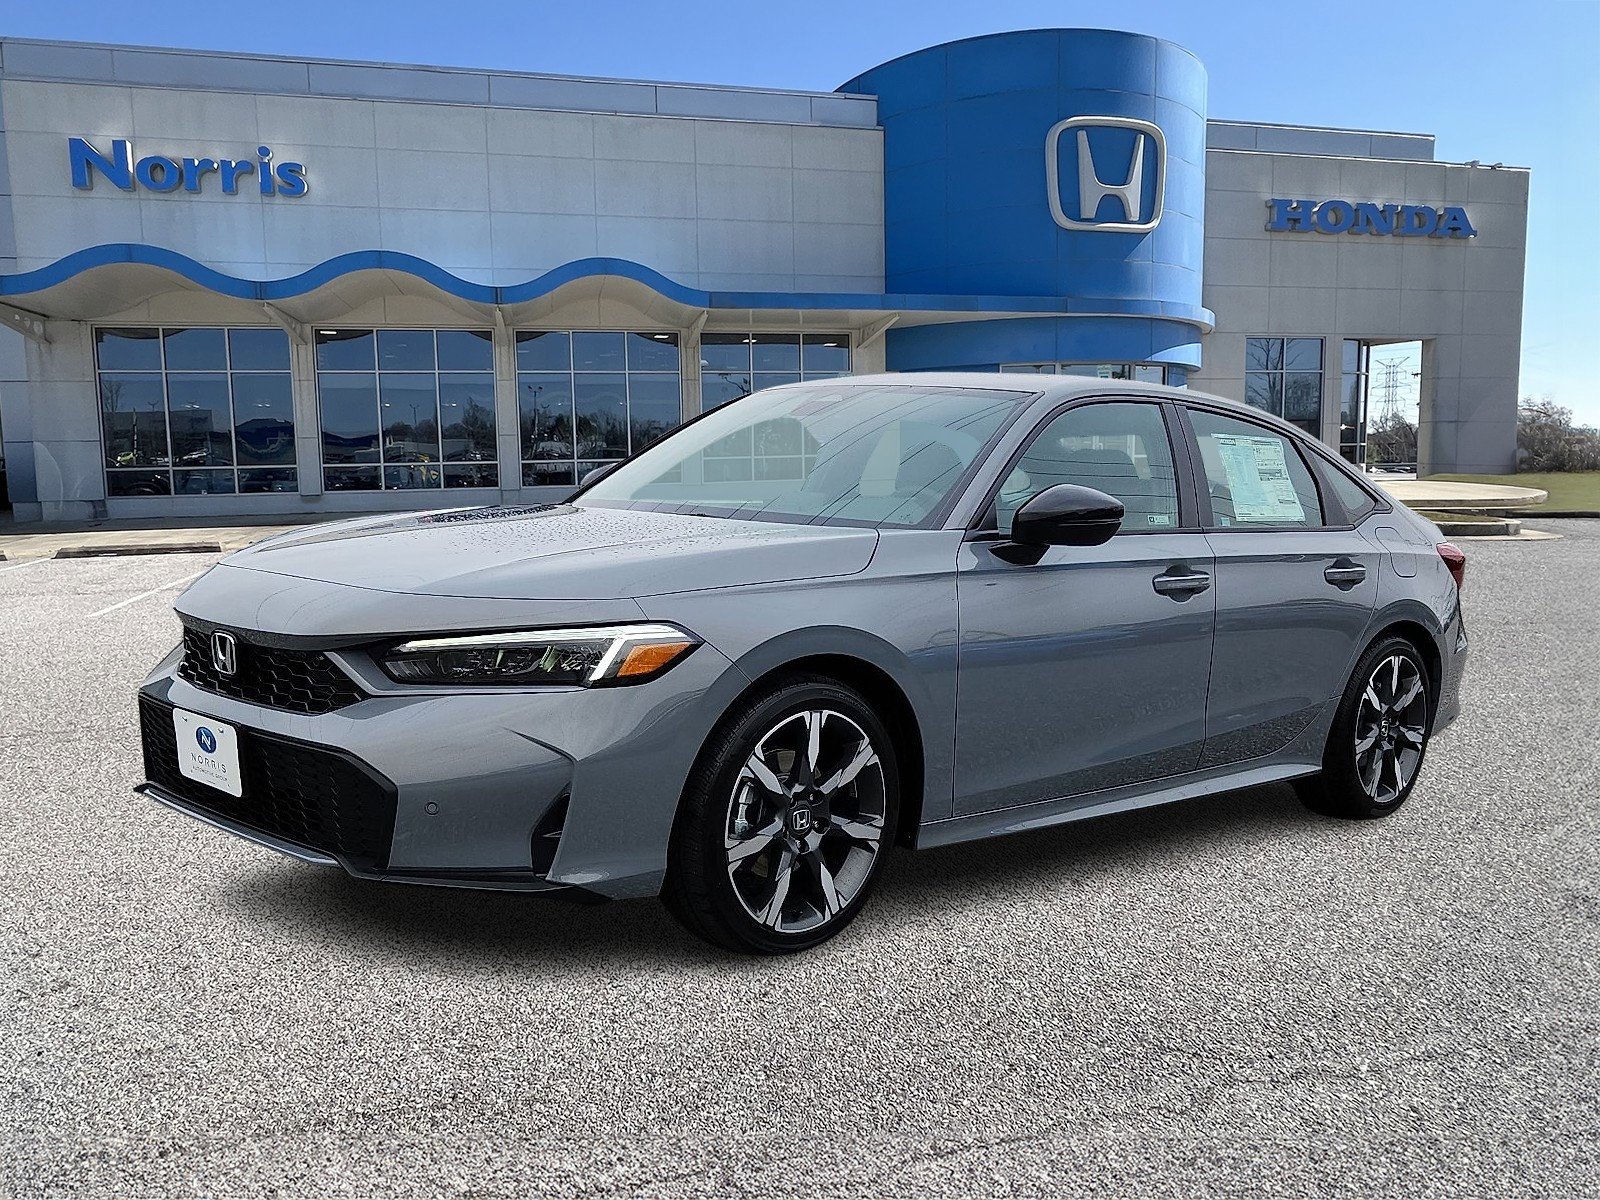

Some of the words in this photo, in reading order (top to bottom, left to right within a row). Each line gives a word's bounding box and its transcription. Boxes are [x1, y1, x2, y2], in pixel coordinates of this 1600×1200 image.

[68, 137, 309, 197] Norris
[1266, 198, 1477, 239] HONDA
[191, 752, 227, 774] NORRIS
